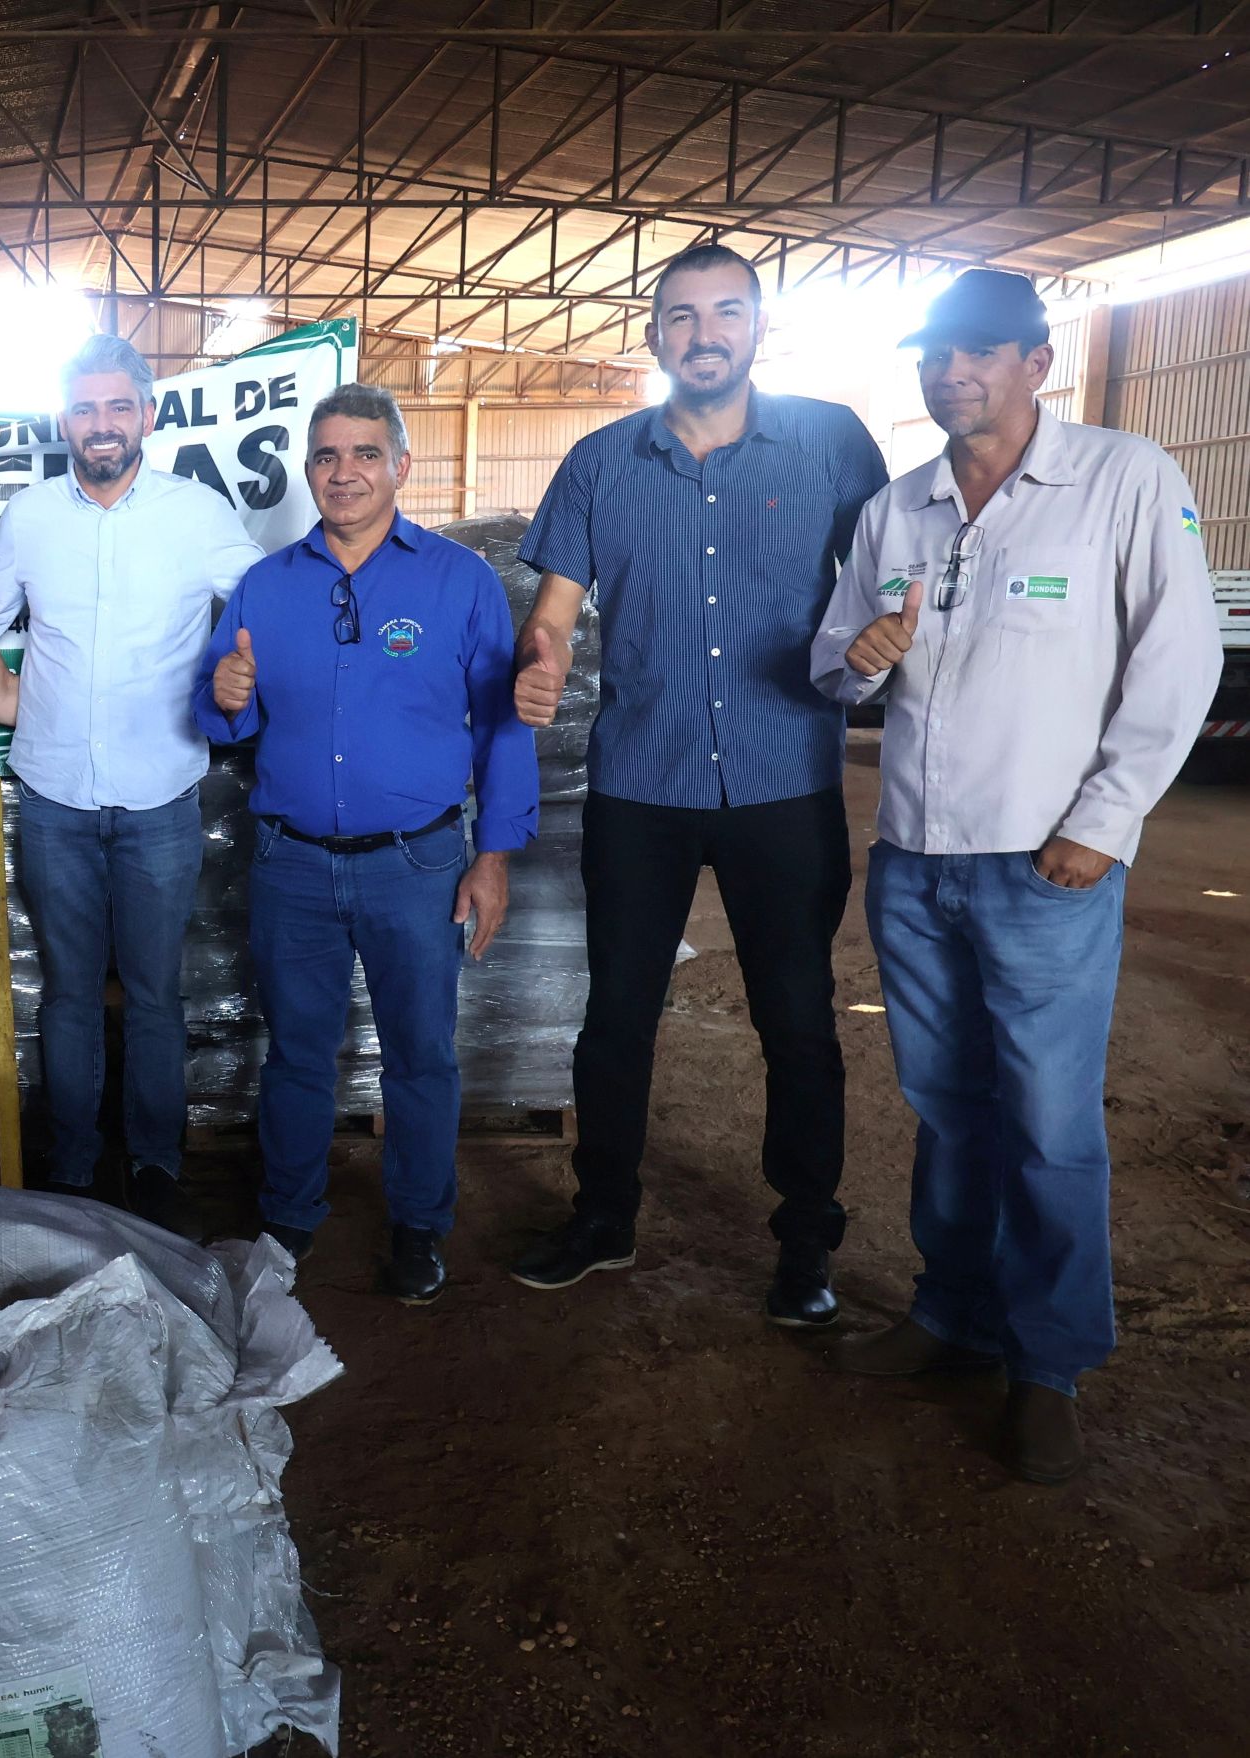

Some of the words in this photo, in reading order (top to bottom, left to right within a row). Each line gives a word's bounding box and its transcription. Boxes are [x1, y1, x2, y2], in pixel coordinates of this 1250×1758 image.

[234, 371, 298, 421] DE
[1028, 584, 1067, 595] RONDÔNIA
[377, 618, 398, 636] CÂMARA
[400, 617, 424, 635] MUNICIPAL
[23, 1684, 55, 1697] humic
